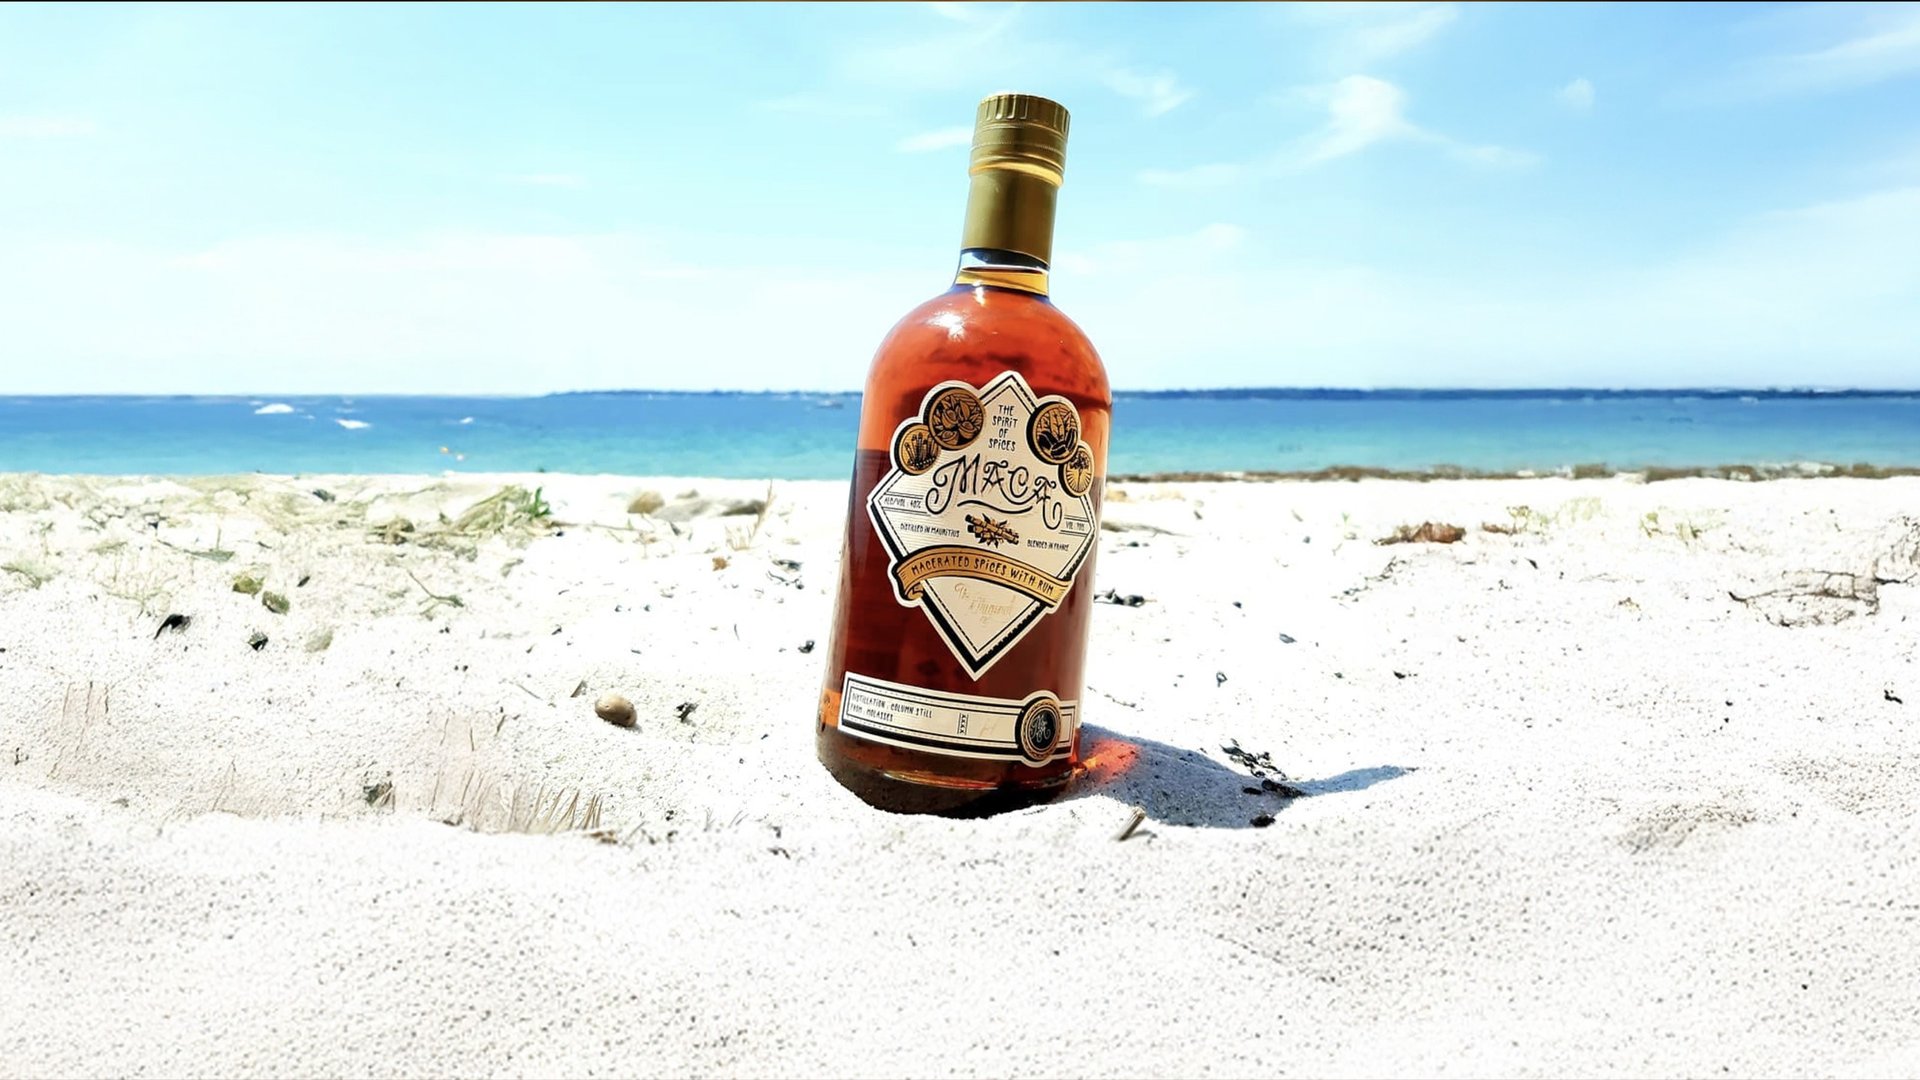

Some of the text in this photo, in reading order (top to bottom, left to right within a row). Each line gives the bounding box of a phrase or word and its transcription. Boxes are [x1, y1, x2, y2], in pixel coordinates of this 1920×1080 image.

[998, 404, 1015, 416] THE
[998, 428, 1009, 438] OF
[925, 453, 1063, 530] MACA
[911, 555, 970, 575] MACERATED
[1038, 578, 1054, 595] RUM
[866, 708, 894, 722] MOLASSES
[890, 703, 915, 715] COLUMN
